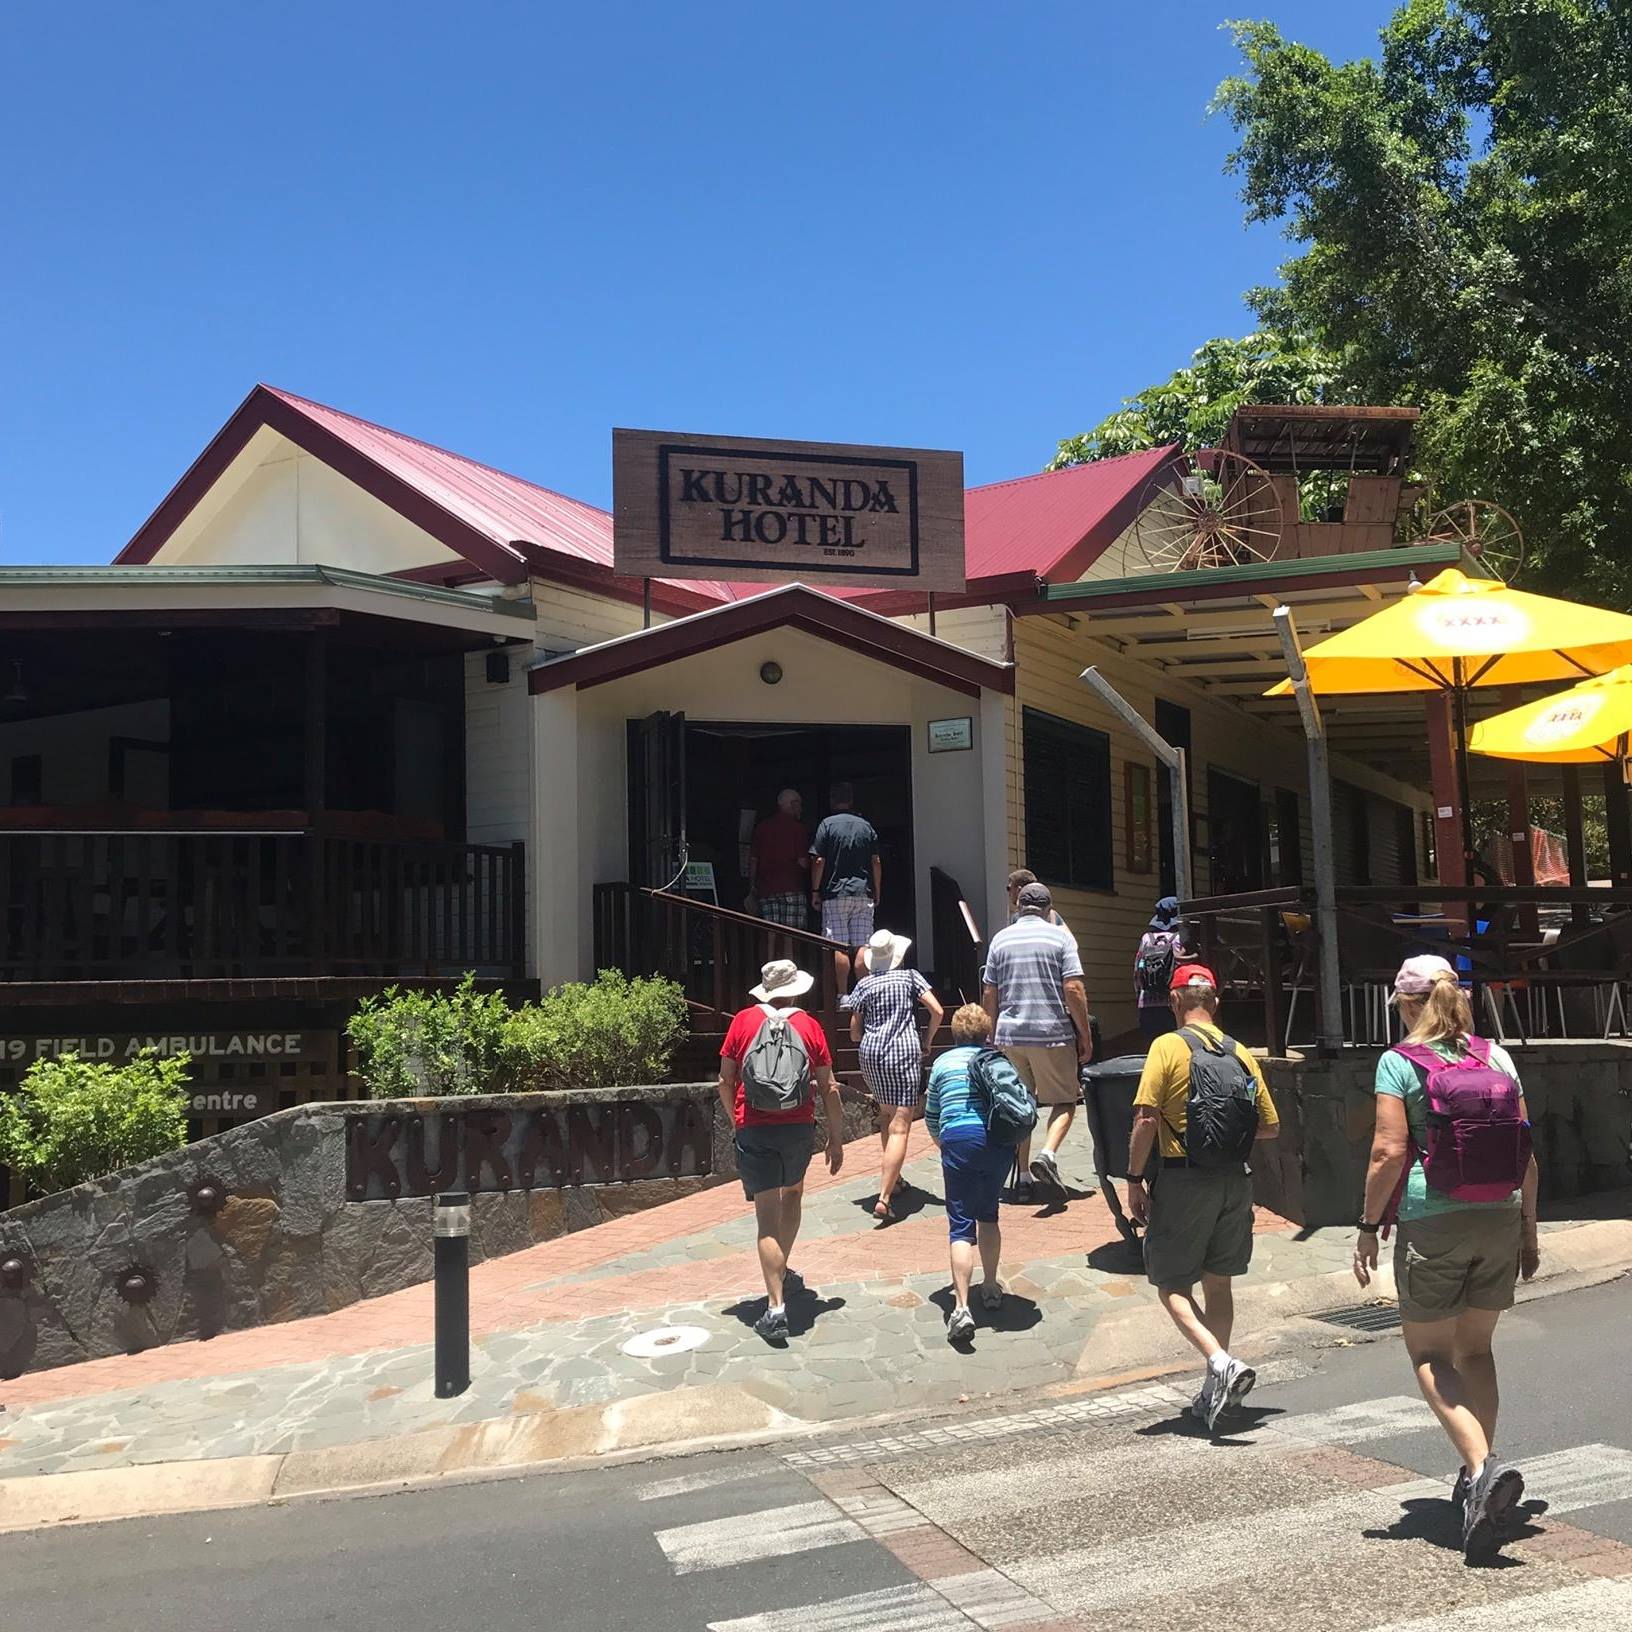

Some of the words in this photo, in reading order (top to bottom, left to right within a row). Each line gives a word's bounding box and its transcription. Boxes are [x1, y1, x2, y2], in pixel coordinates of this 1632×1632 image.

[678, 469, 899, 514] KURANDA
[721, 508, 865, 548] HOTEL
[36, 1038, 115, 1059] FIELD
[124, 1034, 302, 1057] AMBULANCE
[348, 1102, 712, 1199] KURANDA
